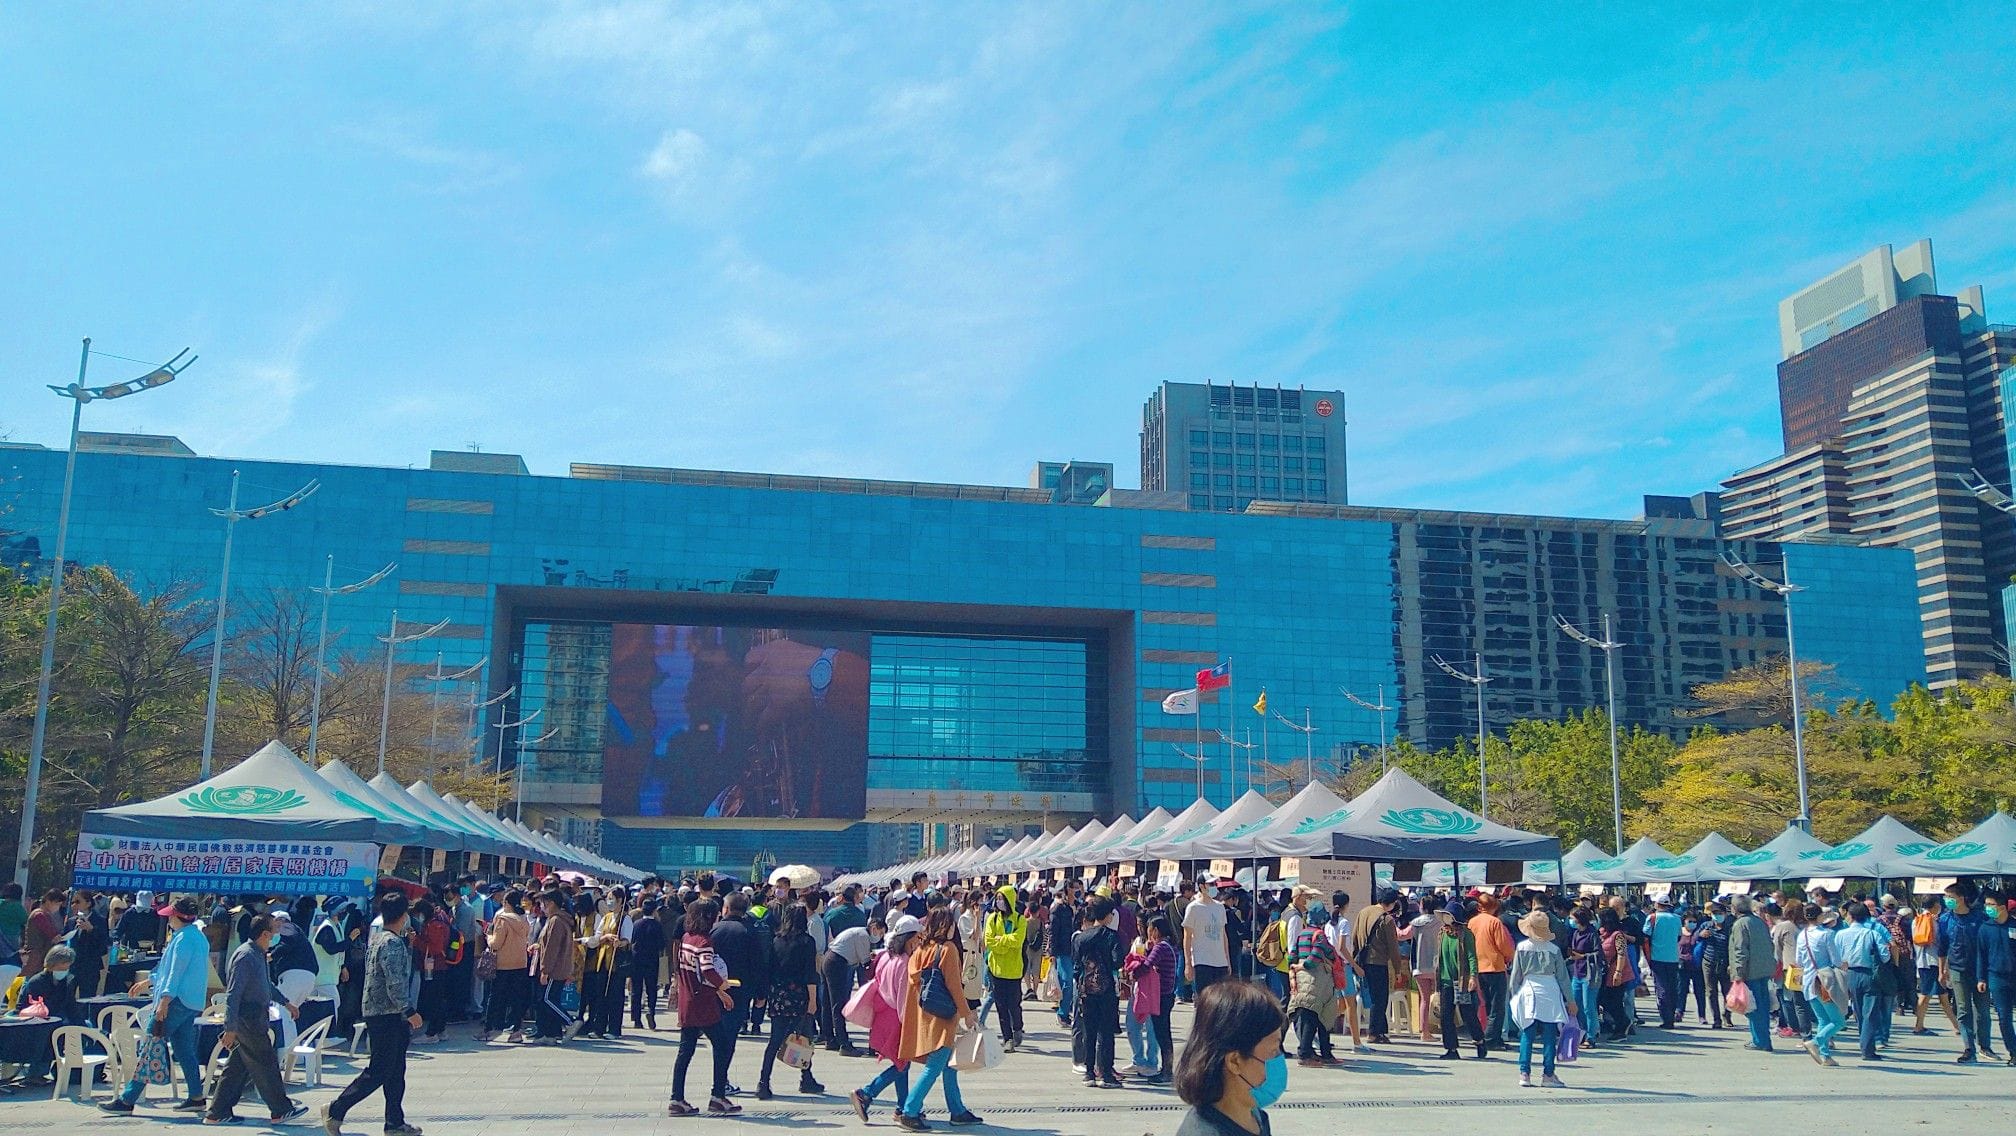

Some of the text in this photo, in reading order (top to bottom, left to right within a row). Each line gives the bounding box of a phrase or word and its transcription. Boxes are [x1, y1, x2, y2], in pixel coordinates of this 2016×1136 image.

[75, 850, 348, 877] 臺中市私立慈濟居家長照機構
